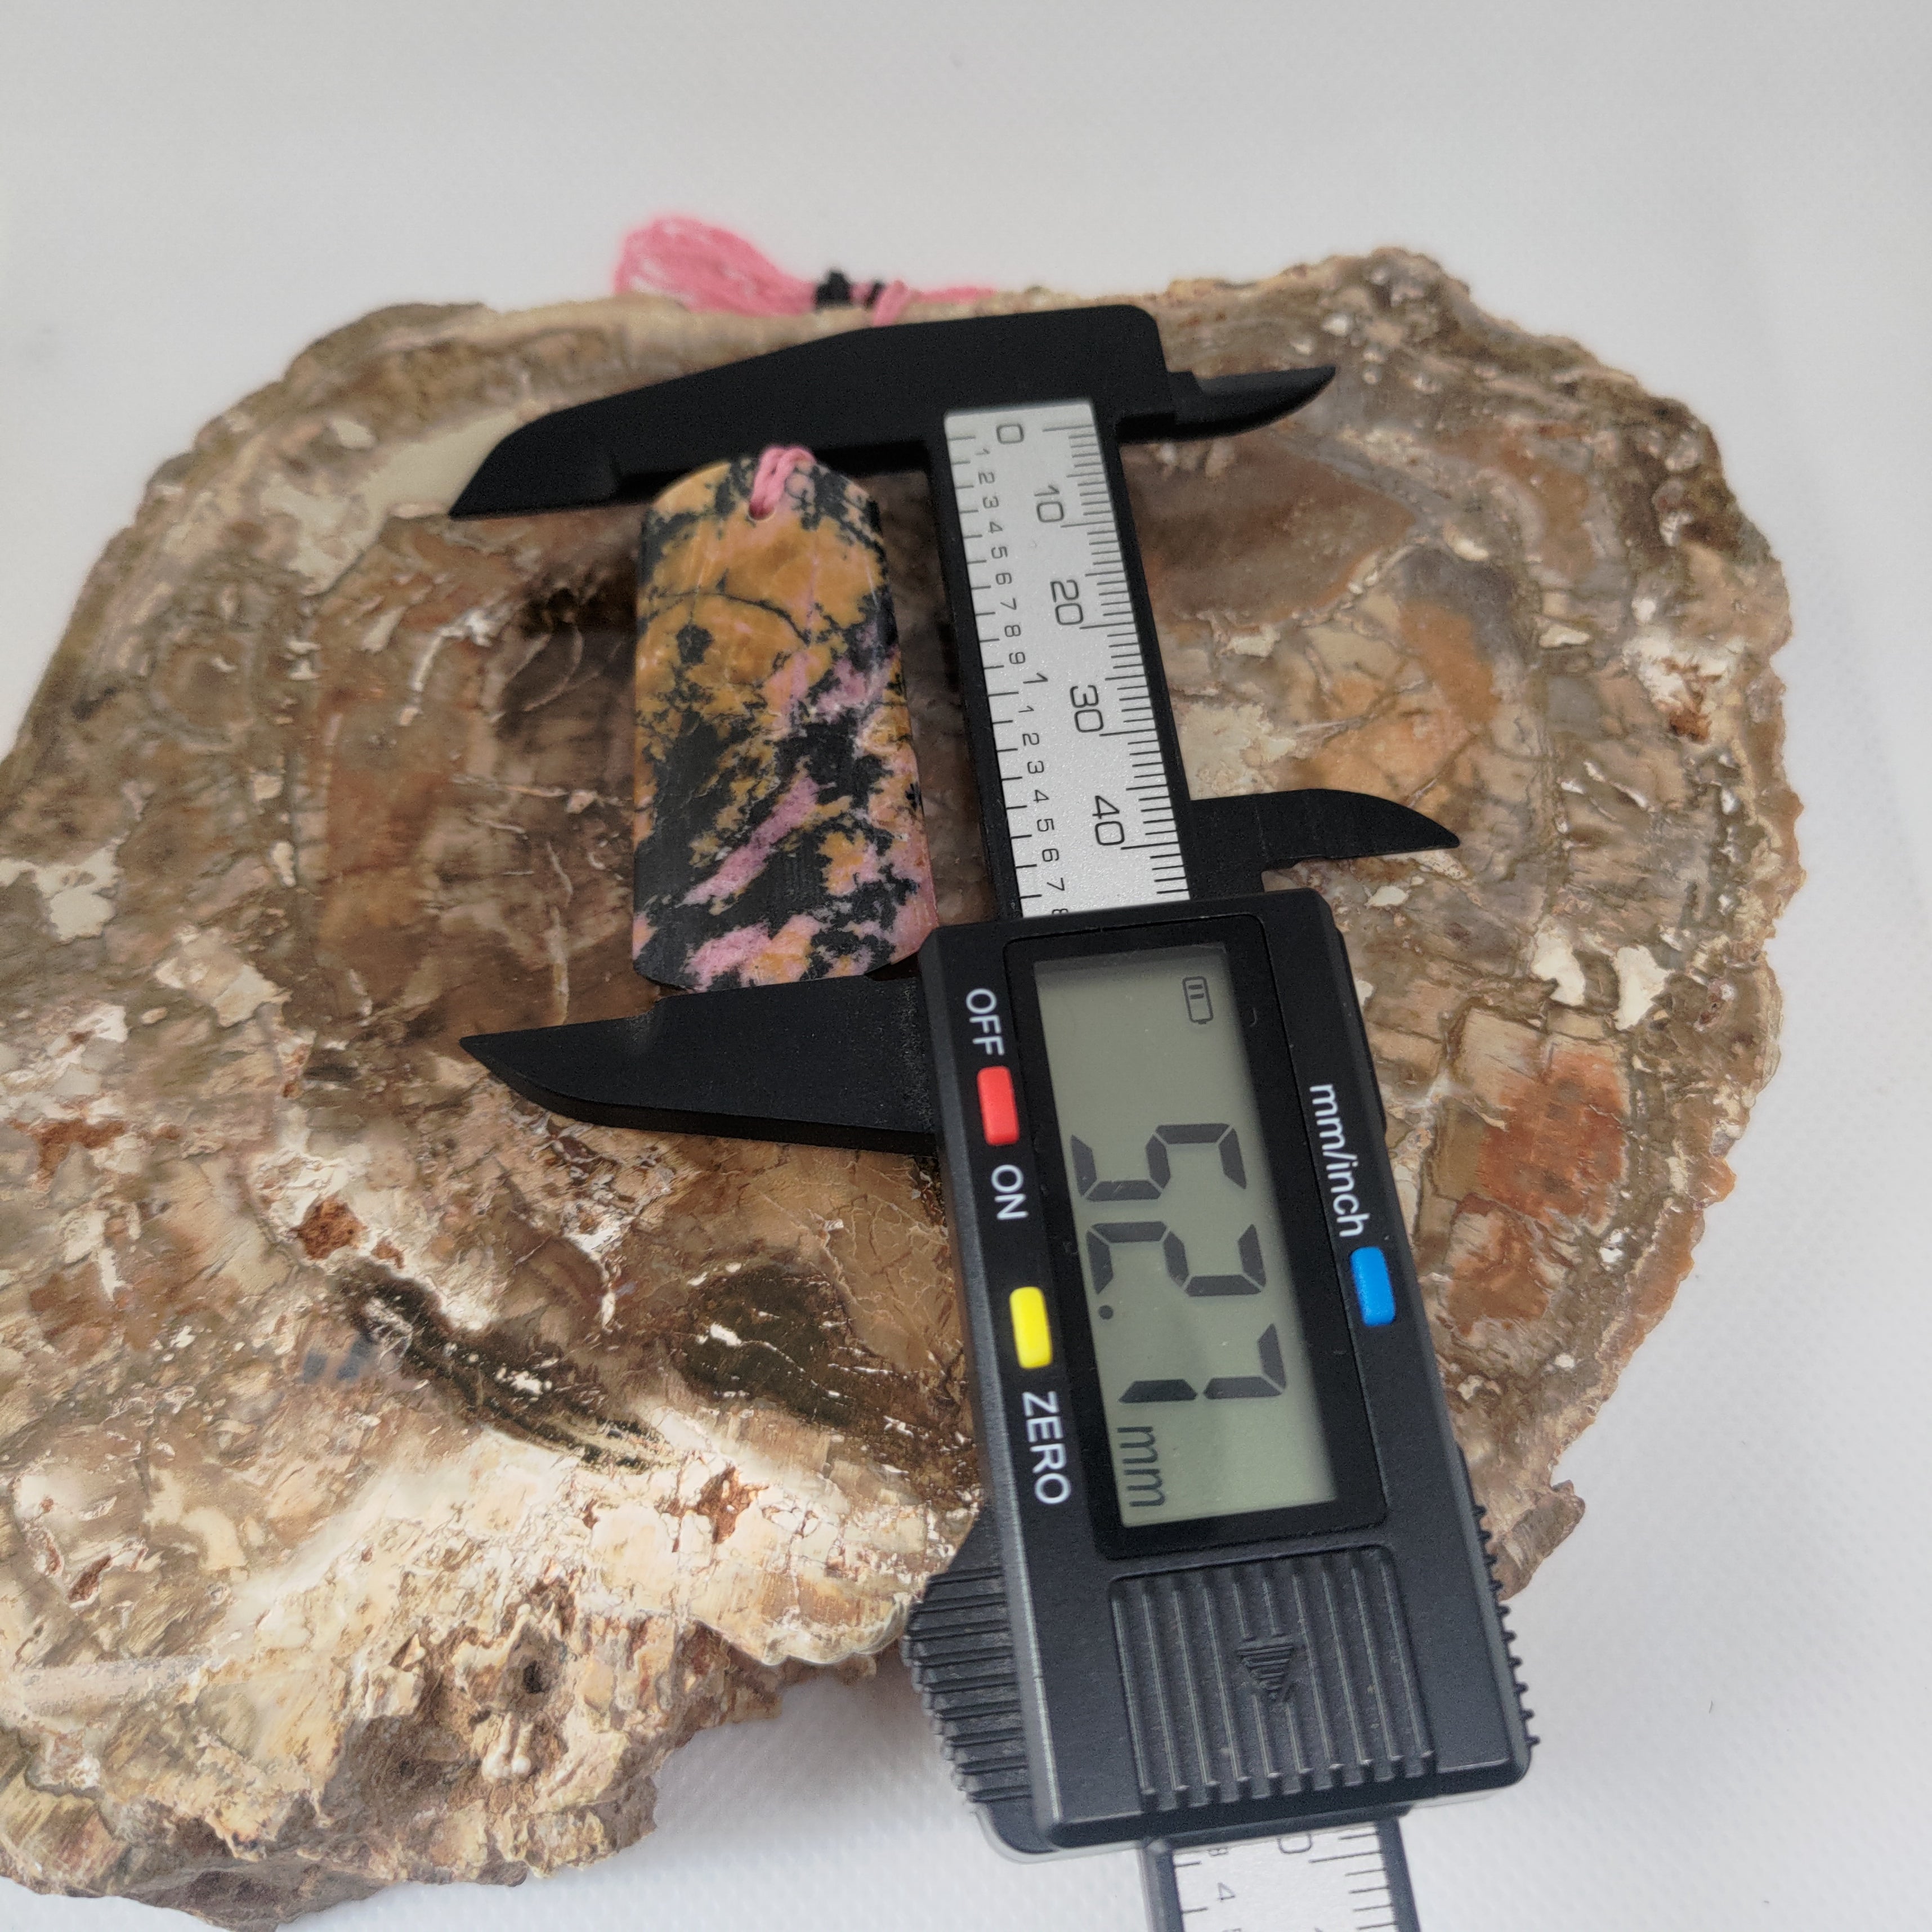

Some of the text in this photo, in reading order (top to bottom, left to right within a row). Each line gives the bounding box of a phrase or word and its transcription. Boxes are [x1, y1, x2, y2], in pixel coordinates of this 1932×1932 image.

[975, 447, 990, 456] 1
[978, 471, 995, 484] 2
[982, 496, 999, 509] 3
[989, 521, 1003, 534] 4
[991, 545, 1008, 559] 5
[995, 572, 1012, 585] 6
[1000, 597, 1017, 610] 7
[995, 423, 1125, 847] 0 10 20 30 40
[1004, 624, 1022, 638] 8
[1008, 651, 1026, 665] 9
[1022, 672, 1048, 685] 1
[1018, 705, 1035, 713] 1
[1022, 732, 1040, 746] 2
[1027, 760, 1045, 774] 3
[1032, 789, 1050, 803] 4
[1036, 818, 1055, 832] 5
[1041, 848, 1060, 862] 6
[1046, 877, 1065, 891] 7
[965, 988, 1005, 1056] OFF
[1309, 1084, 1370, 1237] mm/inch
[991, 1164, 1028, 1220] ON
[1071, 1122, 1287, 1508] 52.7 mm
[1022, 1391, 1071, 1504] ZERO
[1217, 1881, 1236, 1902] 4
